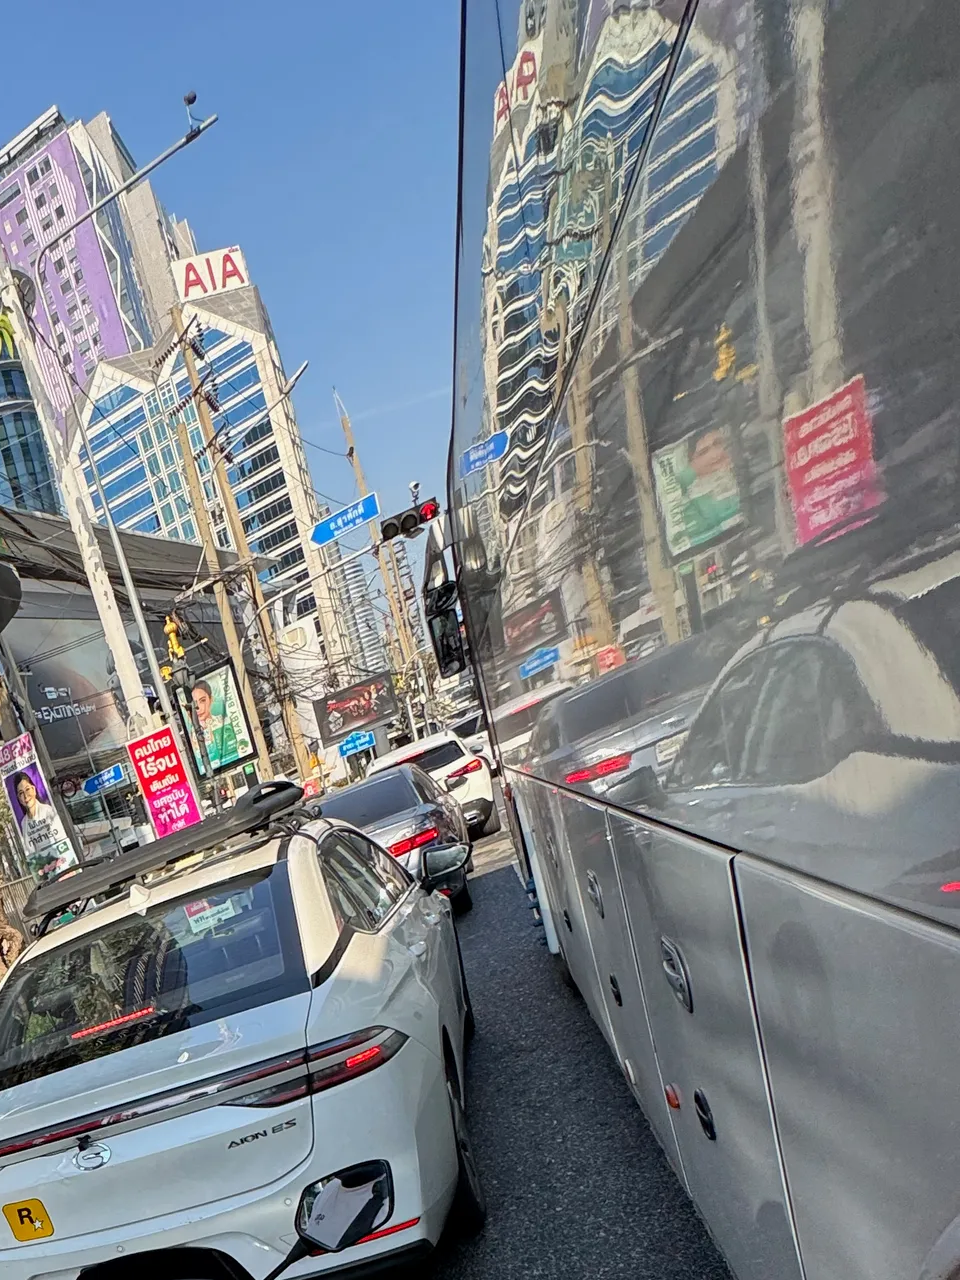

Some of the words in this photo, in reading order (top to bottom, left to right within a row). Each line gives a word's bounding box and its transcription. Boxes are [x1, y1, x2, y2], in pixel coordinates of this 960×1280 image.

[184, 253, 245, 298] AIA
[229, 711, 243, 736] BABY
[134, 735, 172, 760] คนไทย
[138, 751, 178, 779] ไร้จน
[149, 773, 180, 793] เติมเงิน
[153, 788, 185, 809] ยศชนัน
[157, 794, 190, 824] ทำได้
[28, 828, 59, 848] ทำสำเร็จ
[227, 1127, 268, 1150] AION
[271, 1117, 297, 1134] ES
[16, 1206, 34, 1226] R
